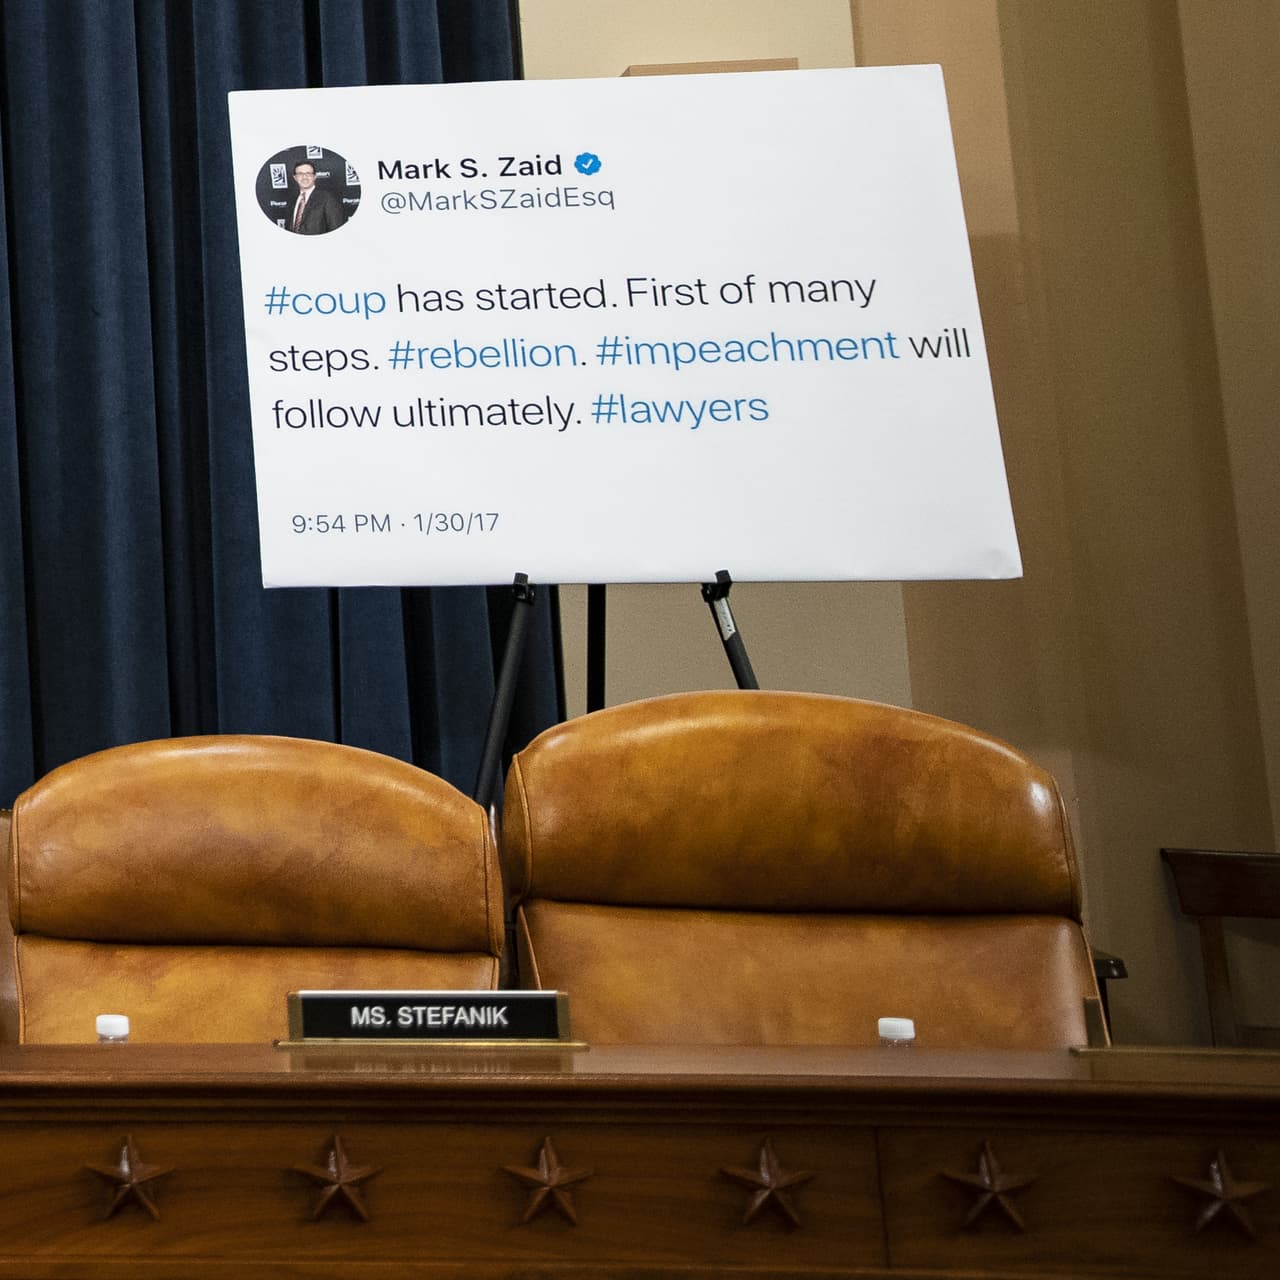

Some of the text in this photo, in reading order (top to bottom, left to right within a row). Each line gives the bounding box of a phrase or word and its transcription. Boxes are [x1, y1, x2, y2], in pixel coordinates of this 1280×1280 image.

[377, 153, 562, 181] Mark S. Zaid
[380, 186, 615, 215] @MarkSZaidEsq
[264, 273, 876, 321] #coup has started. First of many
[269, 327, 971, 378] steps. #rebellion. #impeachment will
[271, 393, 769, 433] follow ultimately. #lawyers
[292, 514, 347, 534] 9:54
[354, 513, 391, 533] PM
[413, 512, 499, 536] 1/30/17
[351, 1006, 508, 1025] MS. STEFANIK
